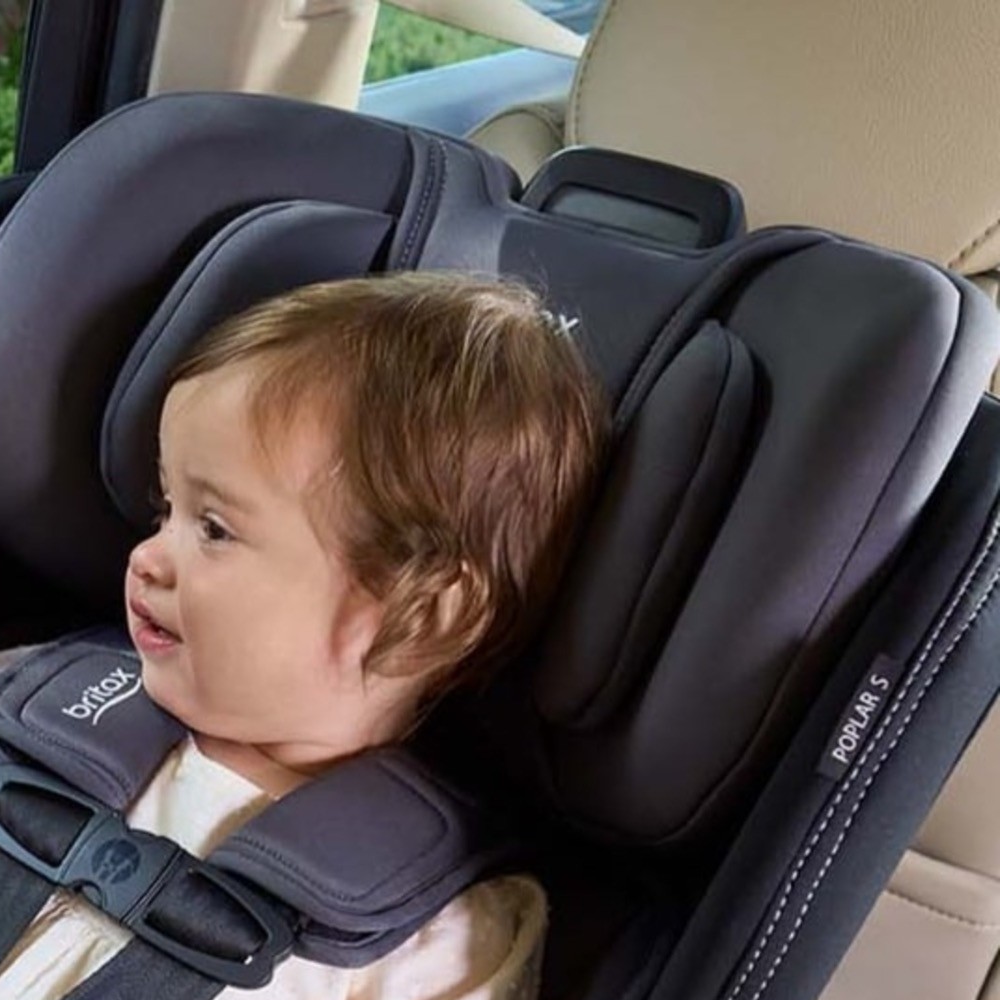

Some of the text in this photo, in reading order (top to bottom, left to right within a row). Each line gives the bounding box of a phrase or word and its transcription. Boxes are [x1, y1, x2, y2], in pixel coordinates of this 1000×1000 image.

[62, 667, 135, 719] britax
[832, 674, 889, 763] POPLAR S
